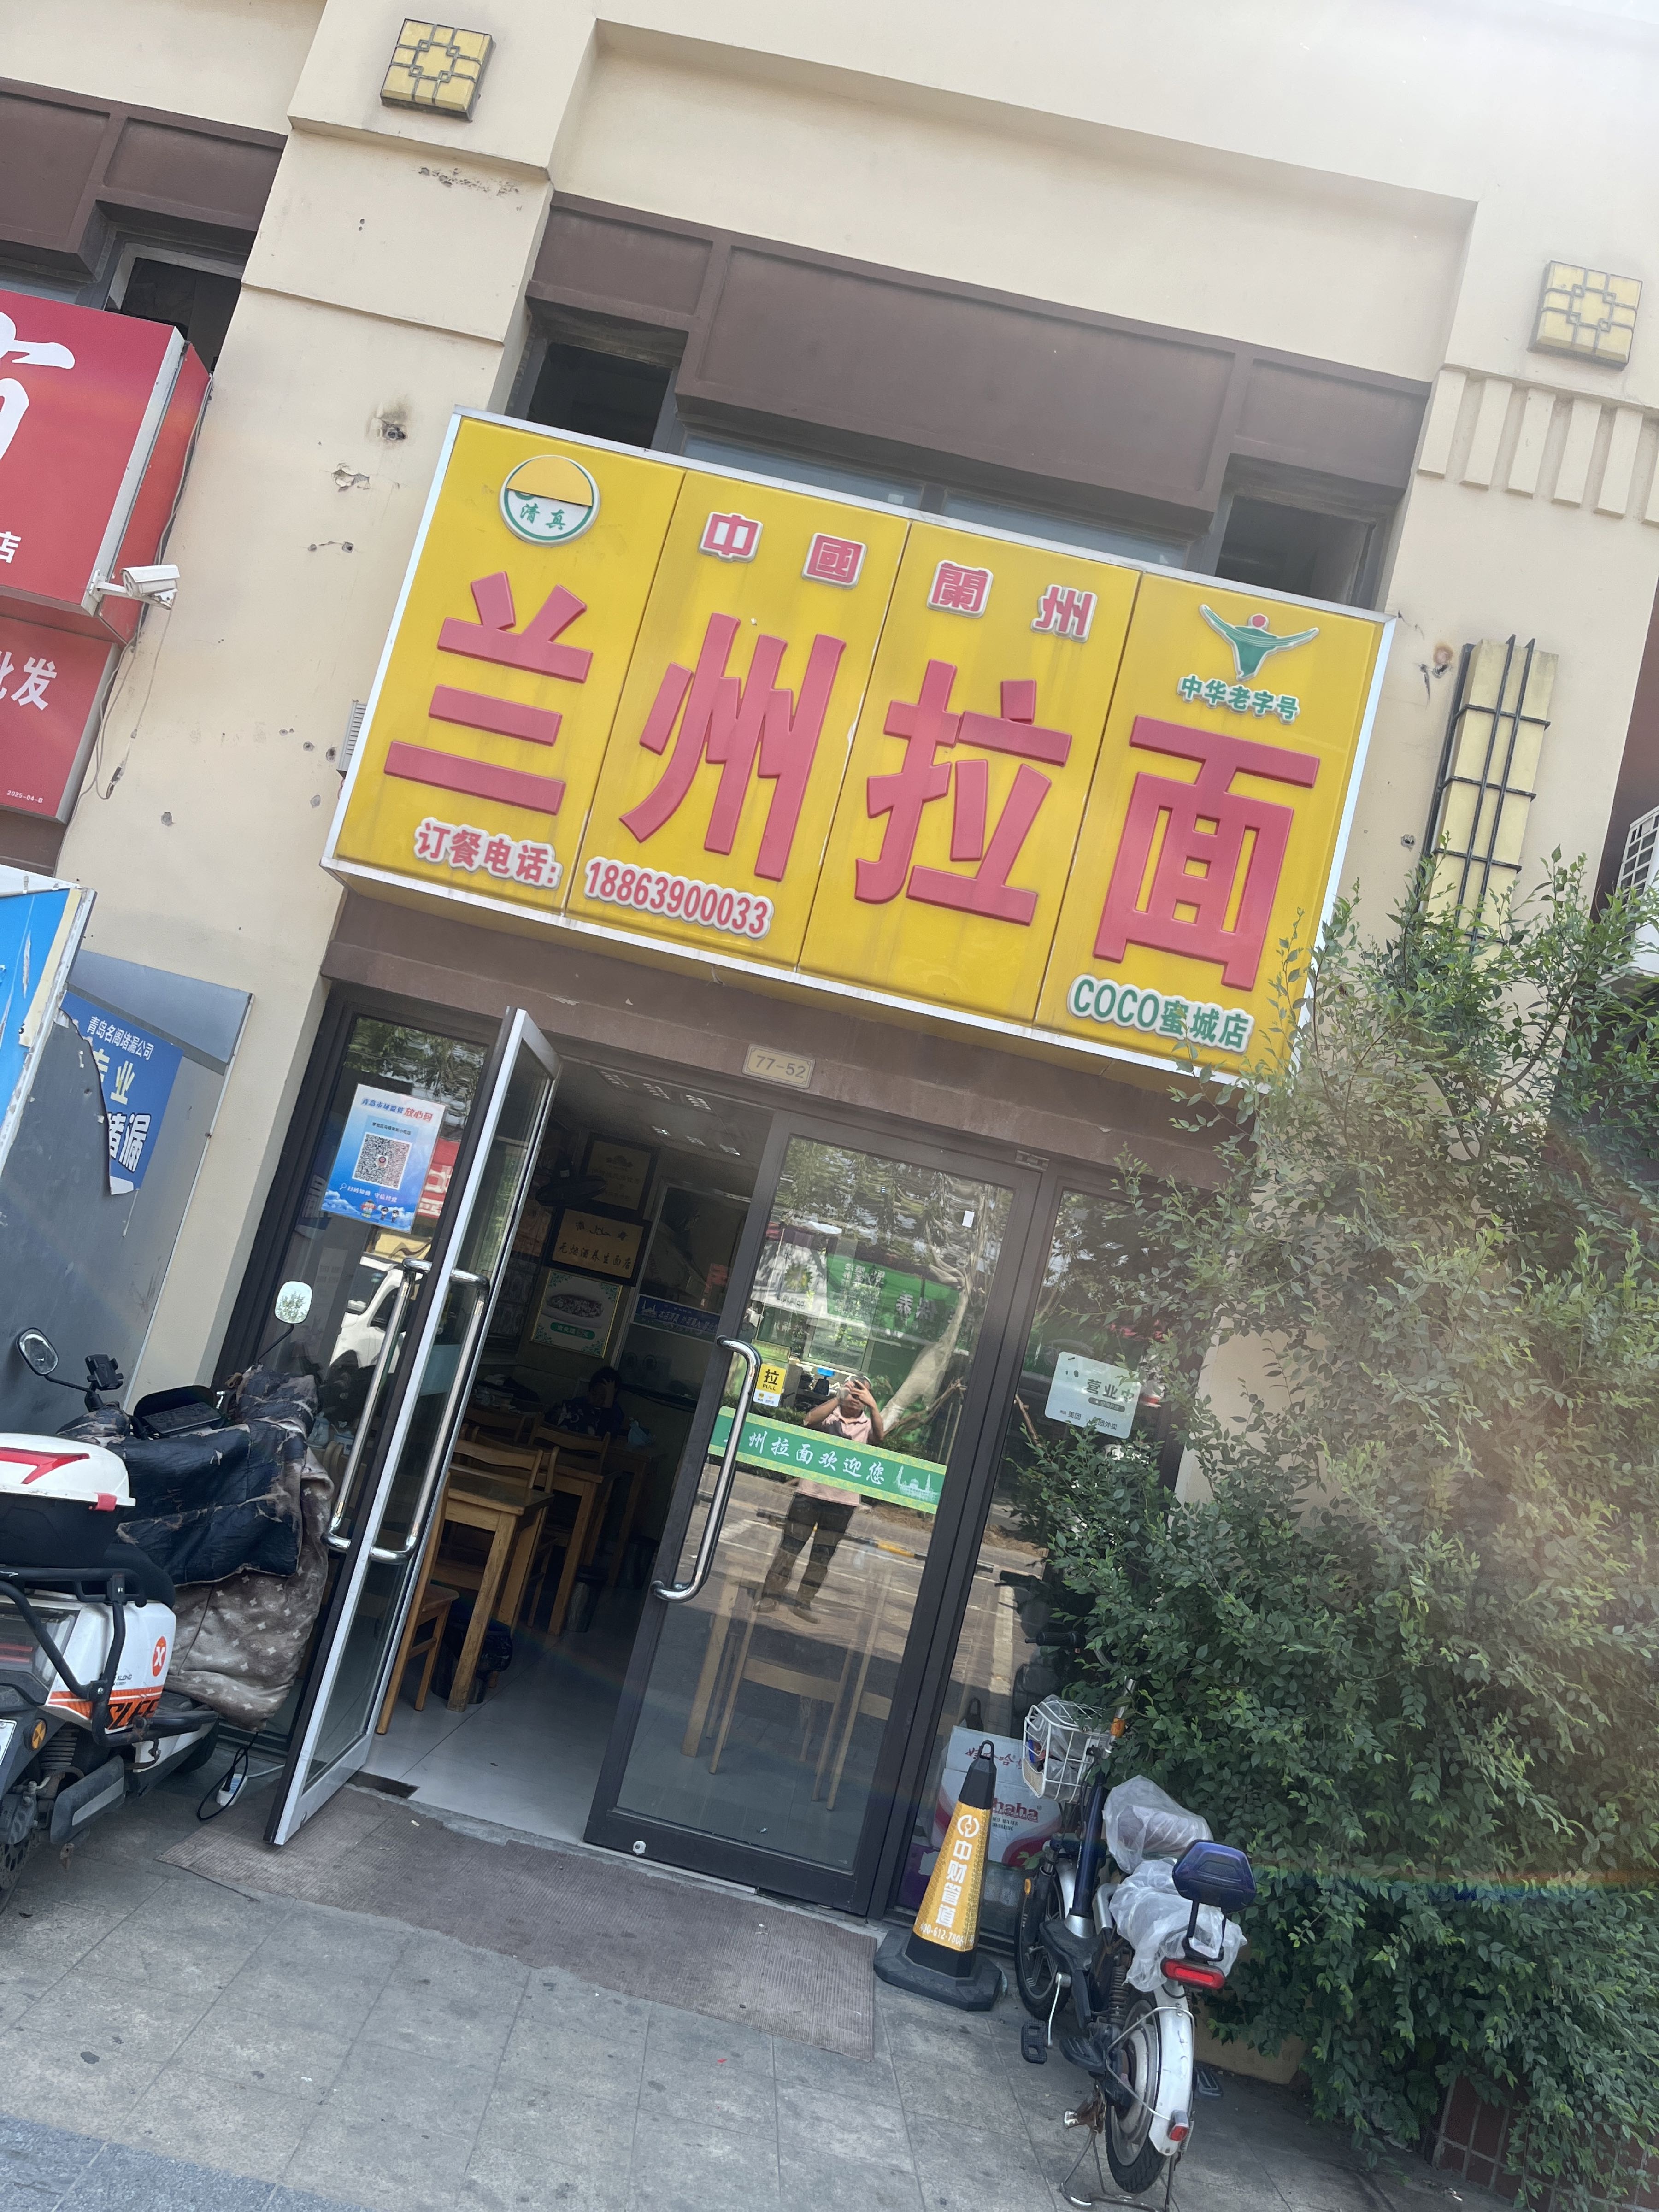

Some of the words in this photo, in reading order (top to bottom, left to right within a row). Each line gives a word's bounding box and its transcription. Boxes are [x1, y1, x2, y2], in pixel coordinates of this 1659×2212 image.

[520, 502, 566, 531] 清真
[1181, 676, 1298, 721] 中华老字号
[6, 790, 43, 803] 2025-04-B
[384, 571, 1320, 991] 兰州拉面
[588, 862, 767, 934] 18863900033
[1074, 978, 1249, 1048] COCO蜜城店
[87, 1016, 154, 1060] 青岛名阁堵漏公司
[756, 1055, 806, 1078] 77-52
[763, 1369, 779, 1385] 拉
[723, 1430, 885, 1485] 州拉面欢迎您
[935, 1840, 972, 1928] 中财管道
